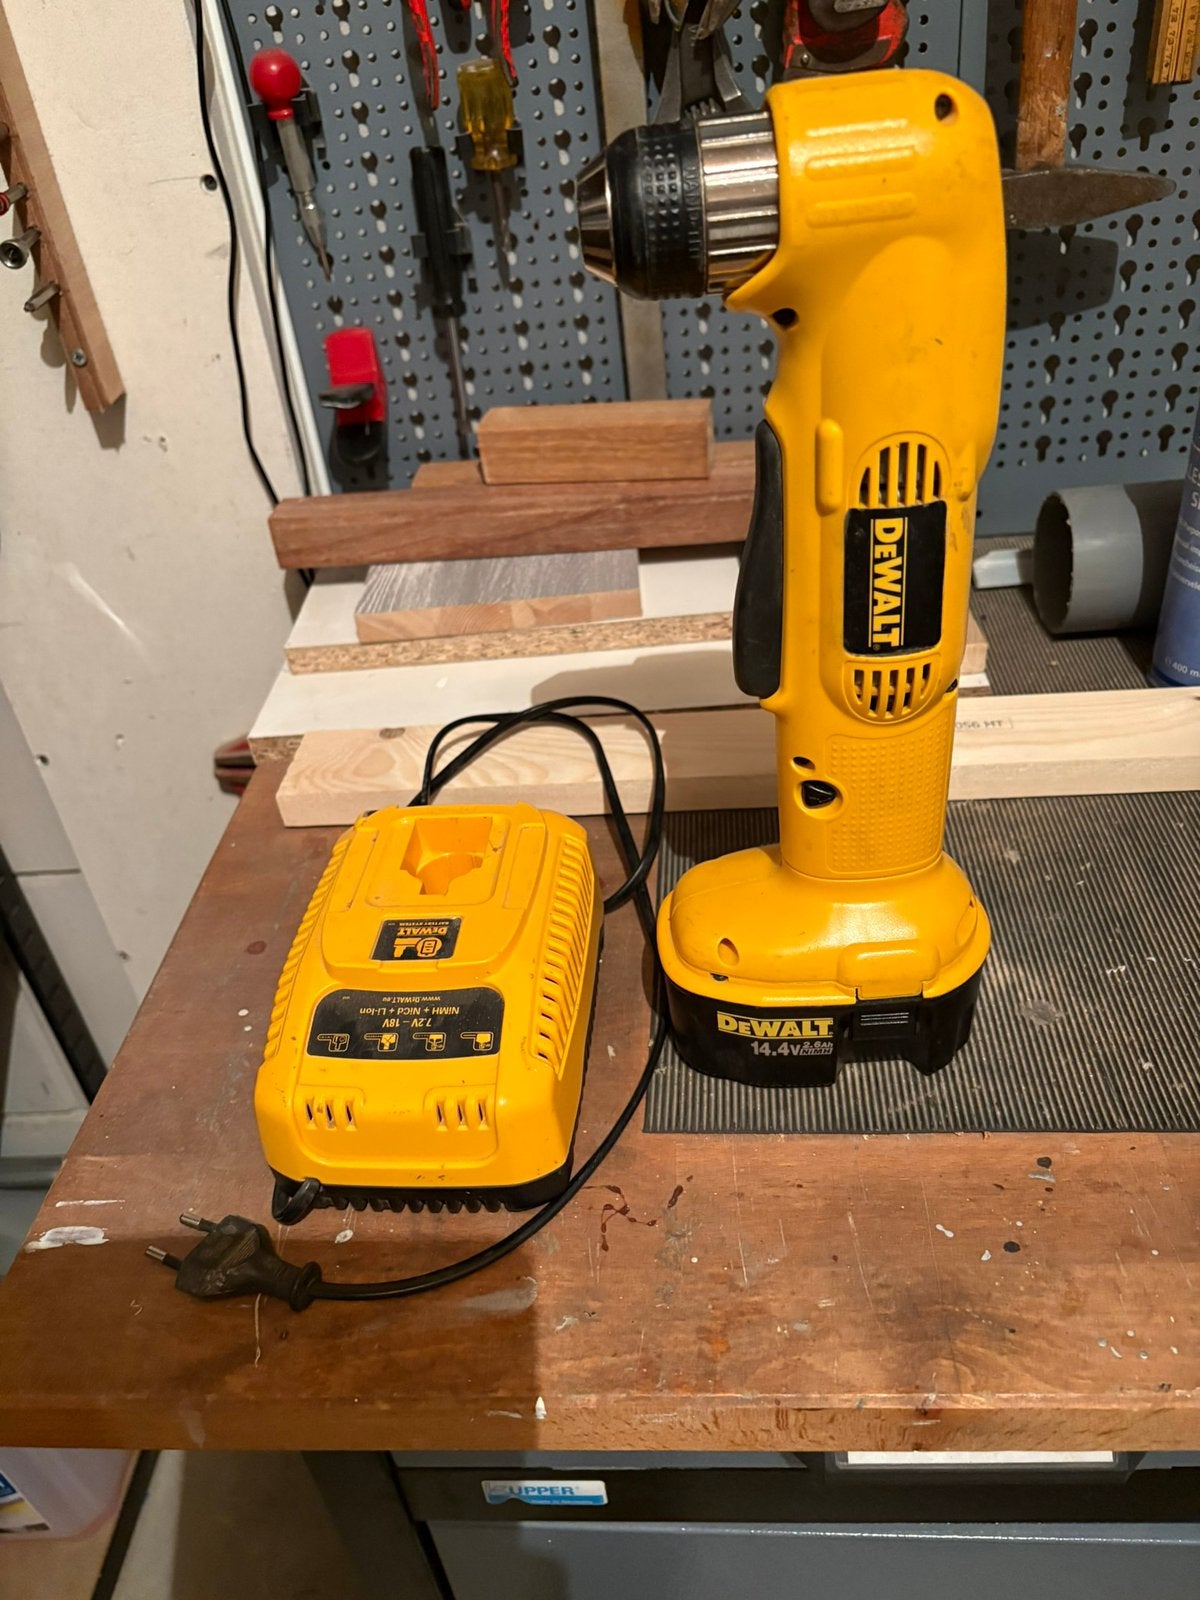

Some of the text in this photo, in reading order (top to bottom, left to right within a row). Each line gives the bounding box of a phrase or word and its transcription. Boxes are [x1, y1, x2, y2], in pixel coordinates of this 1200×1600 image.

[359, 1007, 387, 1016] Li-Ion
[397, 1007, 421, 1015] NiCd
[432, 1006, 460, 1015] NiMH
[382, 1018, 401, 1028] 18V
[411, 1017, 432, 1028] 7.2V
[751, 1041, 800, 1056] 14.4V
